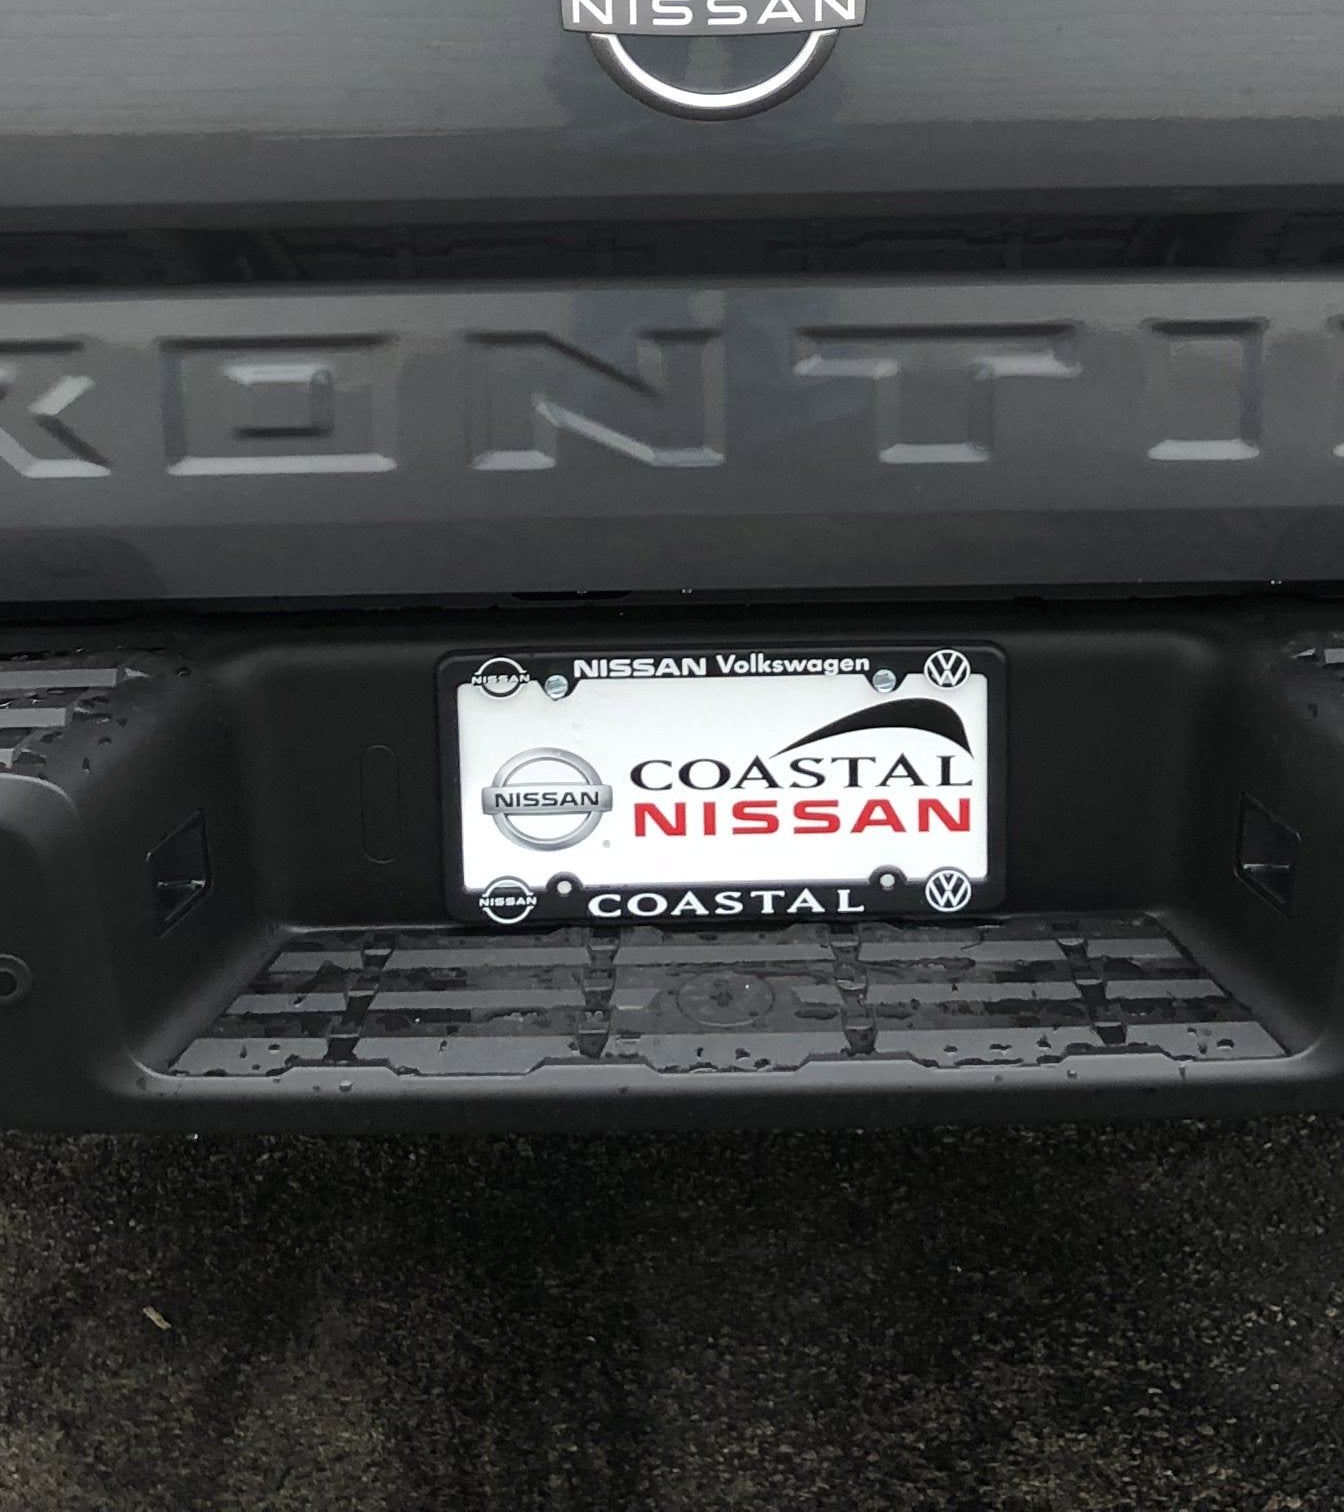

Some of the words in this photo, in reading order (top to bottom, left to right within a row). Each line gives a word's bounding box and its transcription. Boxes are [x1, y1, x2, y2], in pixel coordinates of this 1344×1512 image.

[573, 657, 707, 679] NISSAN
[715, 653, 871, 676] Volkswagen
[471, 672, 530, 687] NISSAN
[629, 753, 973, 791] COASTAL
[494, 789, 600, 809] NISSAN
[633, 797, 972, 838] NISSAN
[479, 893, 538, 909] NISSAN
[587, 888, 865, 918] COASTAL
